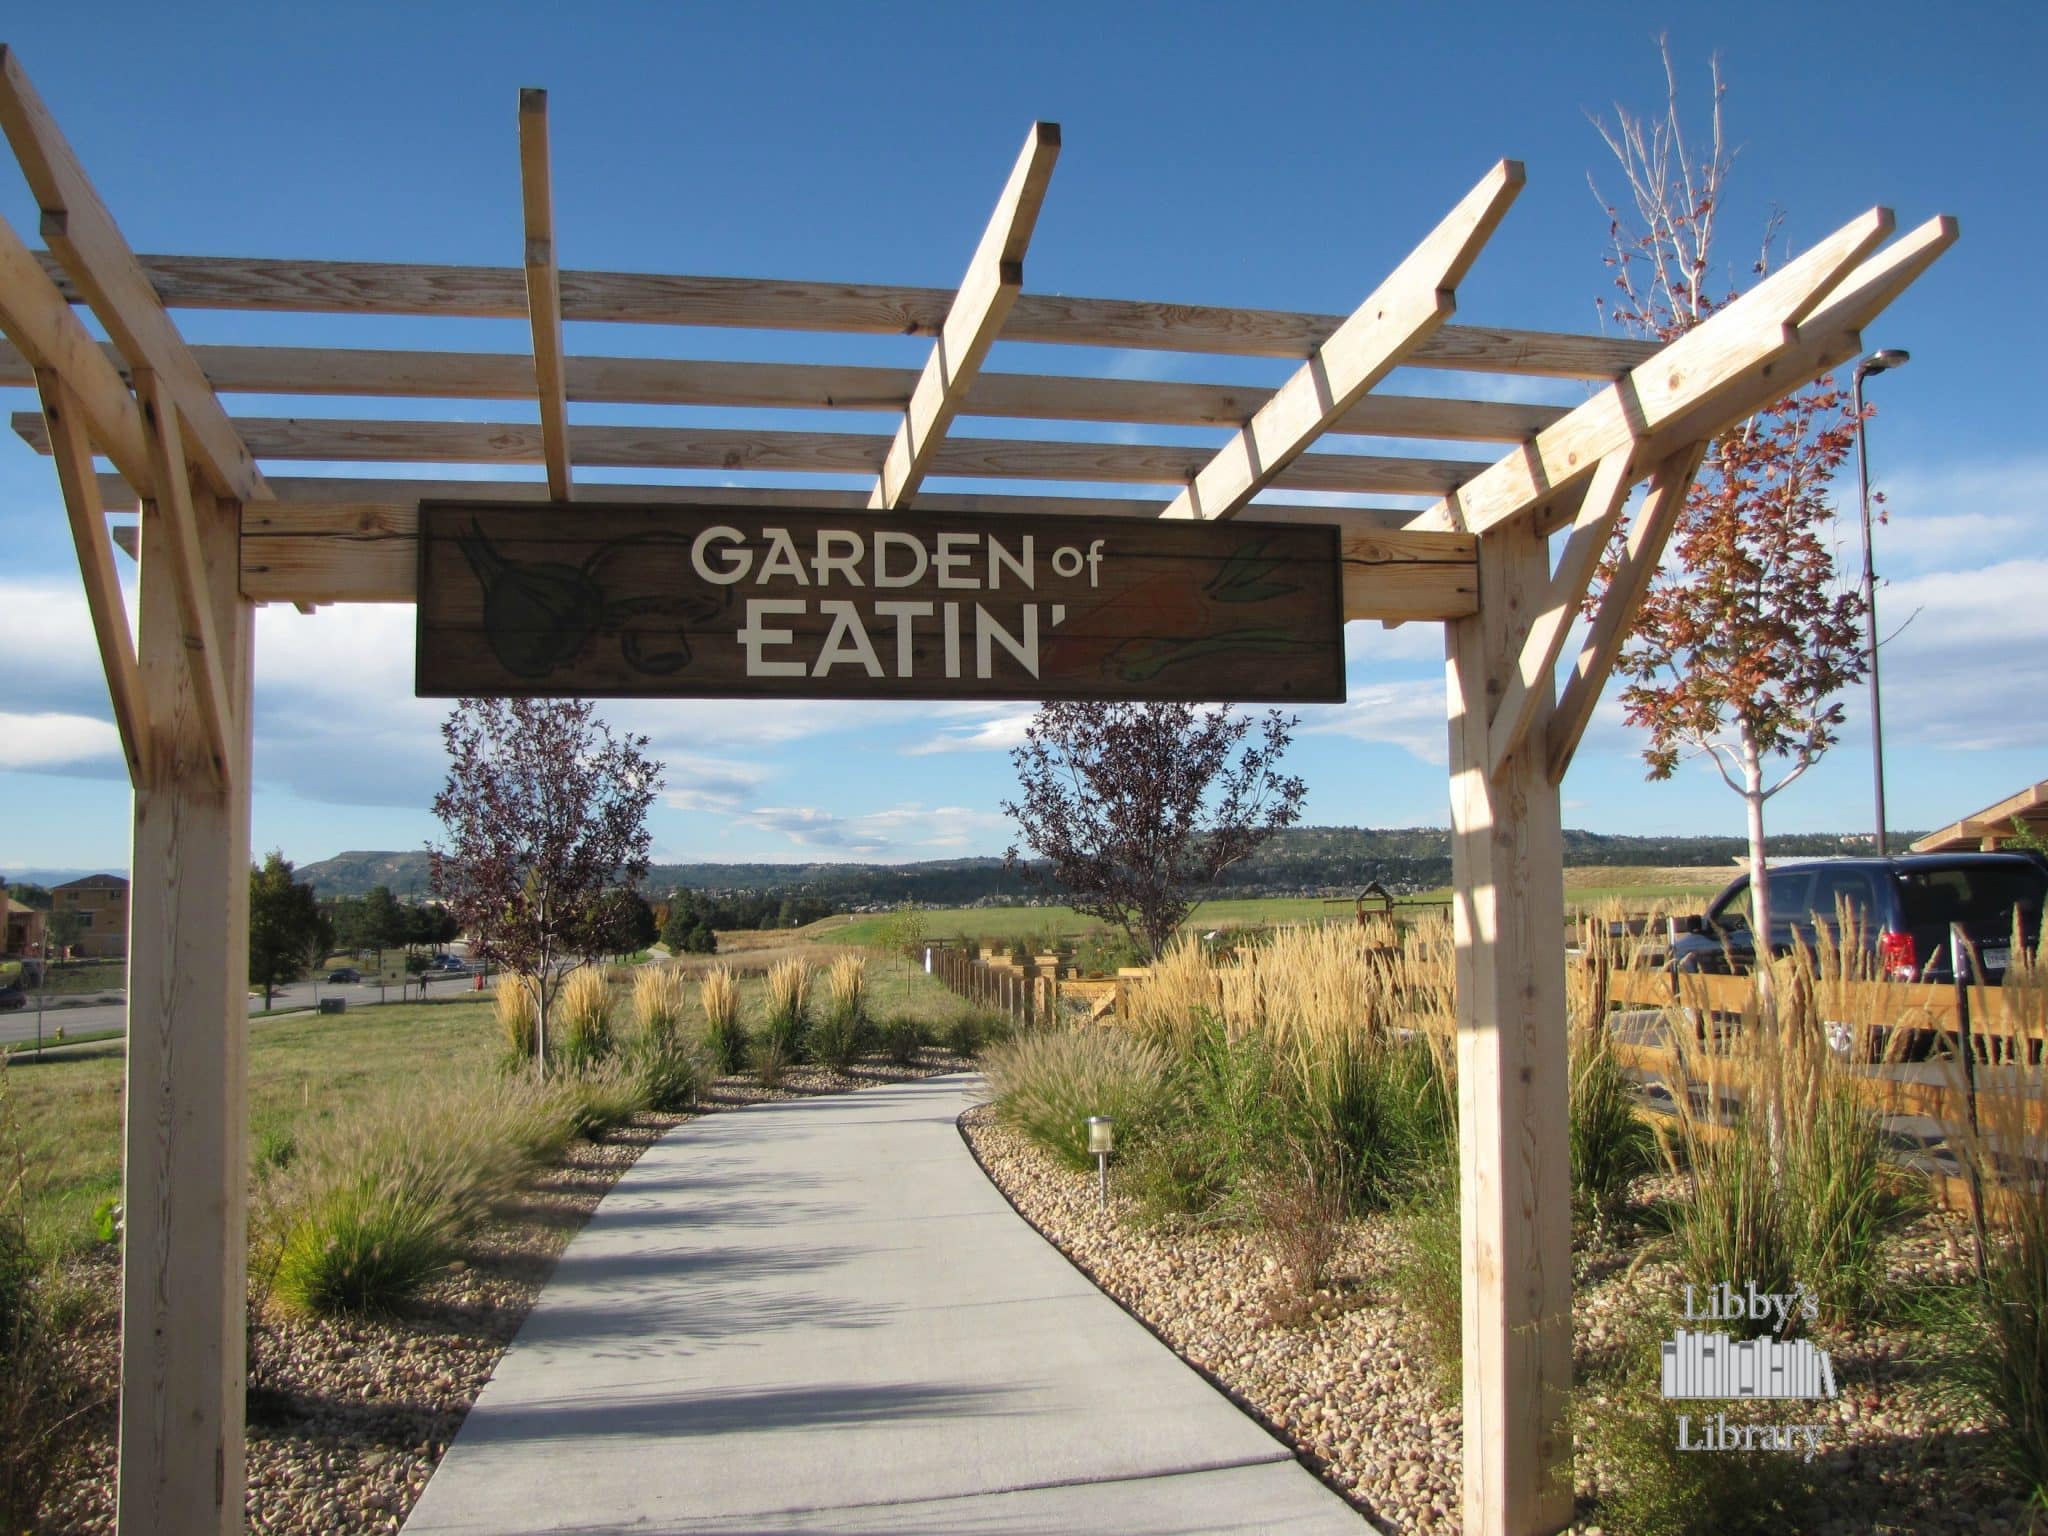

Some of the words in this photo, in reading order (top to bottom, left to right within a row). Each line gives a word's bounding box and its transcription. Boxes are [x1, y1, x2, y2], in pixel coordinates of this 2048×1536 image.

[691, 525, 1035, 591] GARDEN
[1052, 540, 1105, 588] of
[737, 599, 1066, 680] EATIN'
